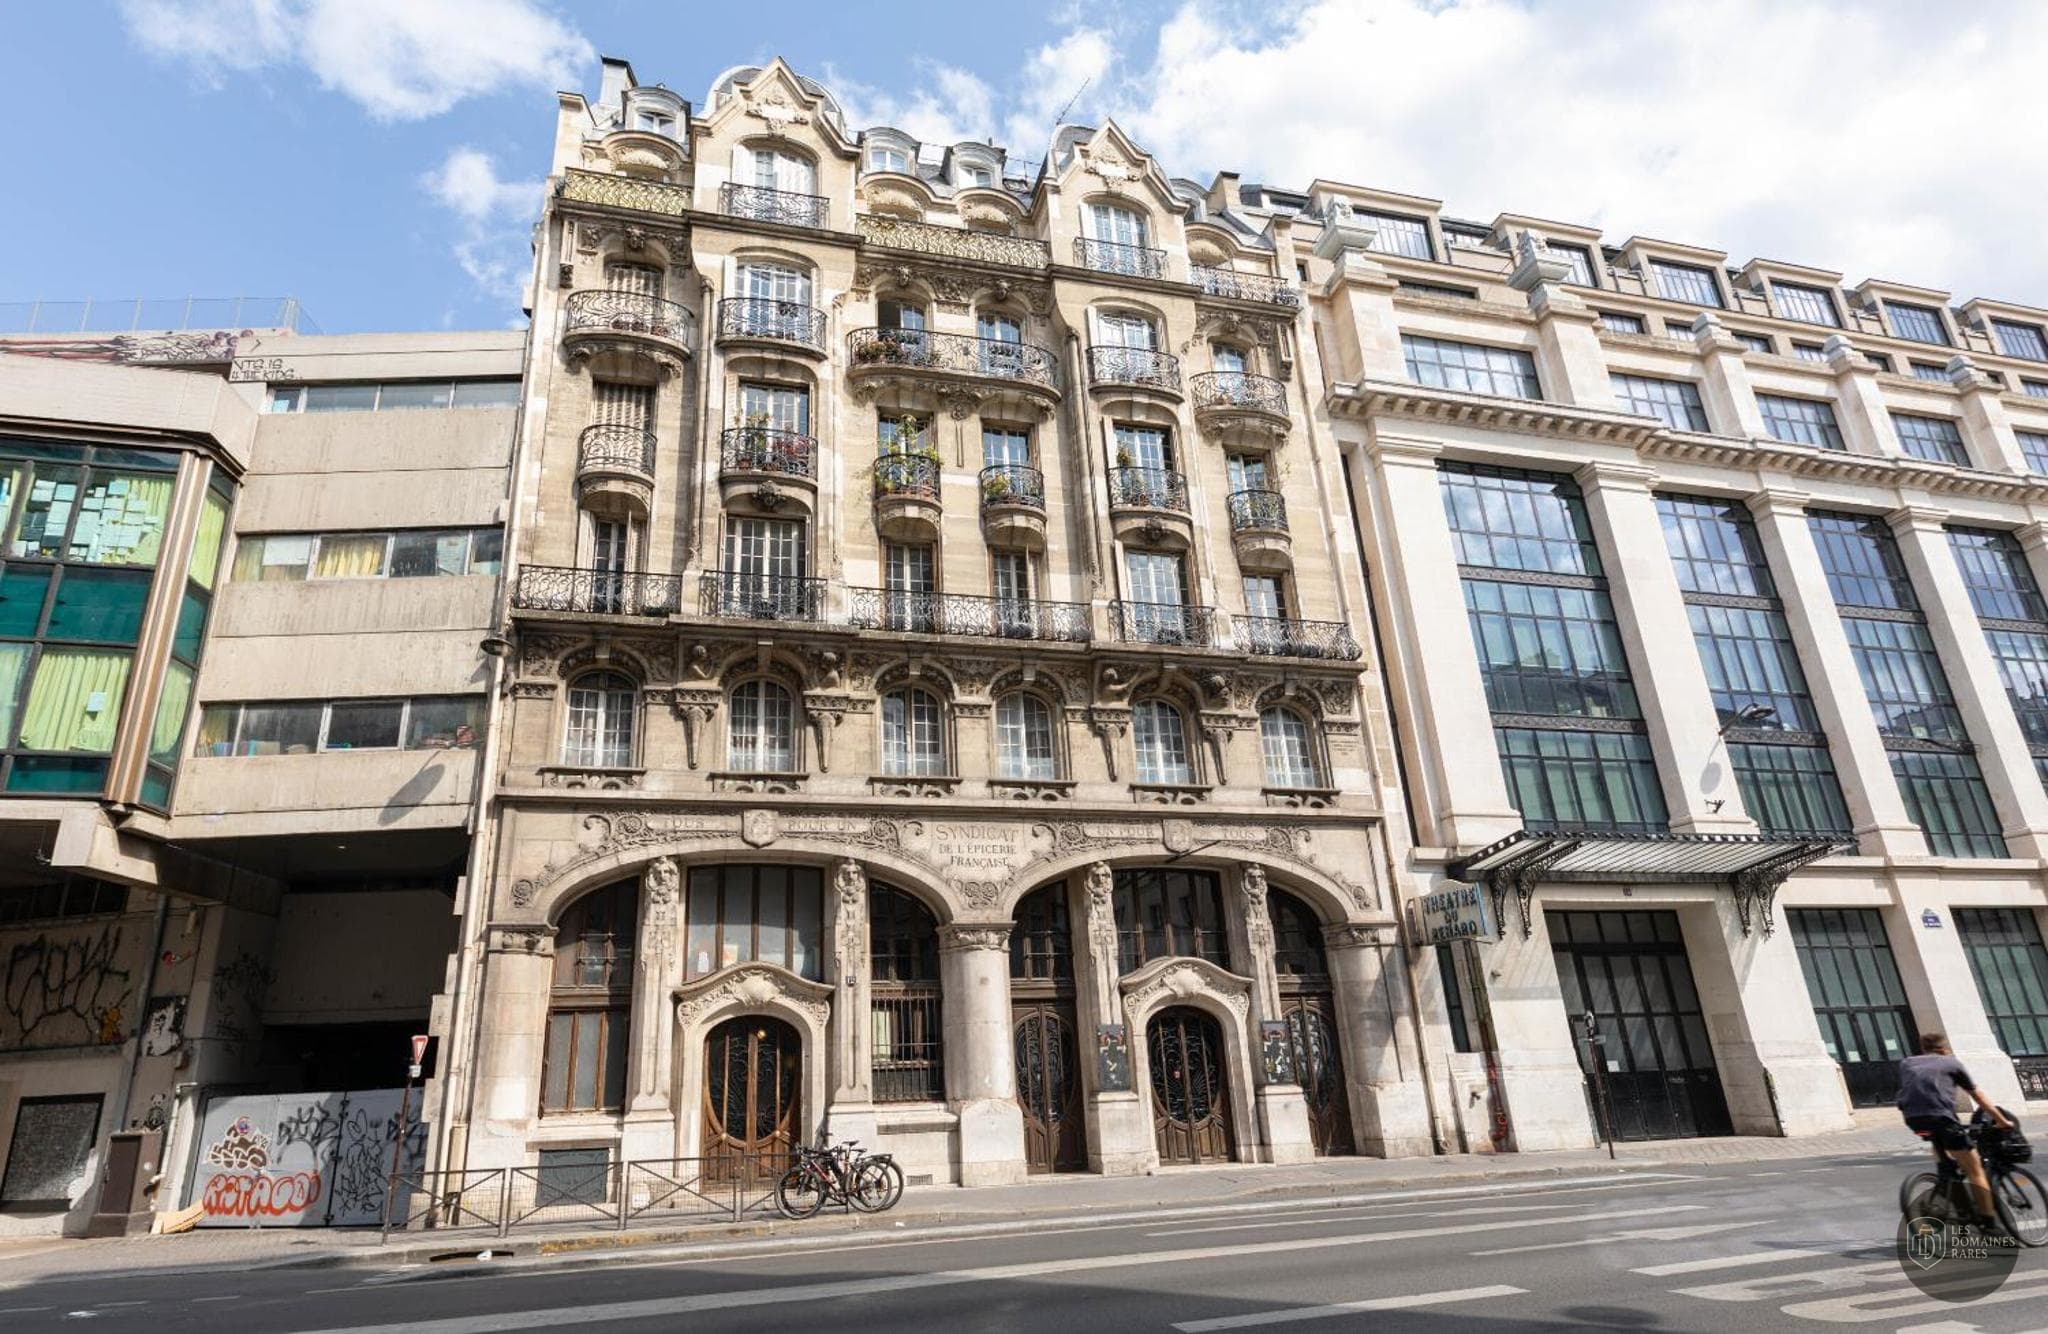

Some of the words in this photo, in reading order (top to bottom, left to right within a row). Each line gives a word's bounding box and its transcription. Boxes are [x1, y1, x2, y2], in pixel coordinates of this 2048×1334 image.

[241, 369, 261, 380] THE
[935, 824, 1019, 843] SYNDICAT
[938, 843, 953, 855] DE
[1431, 920, 1478, 942] RENARD
